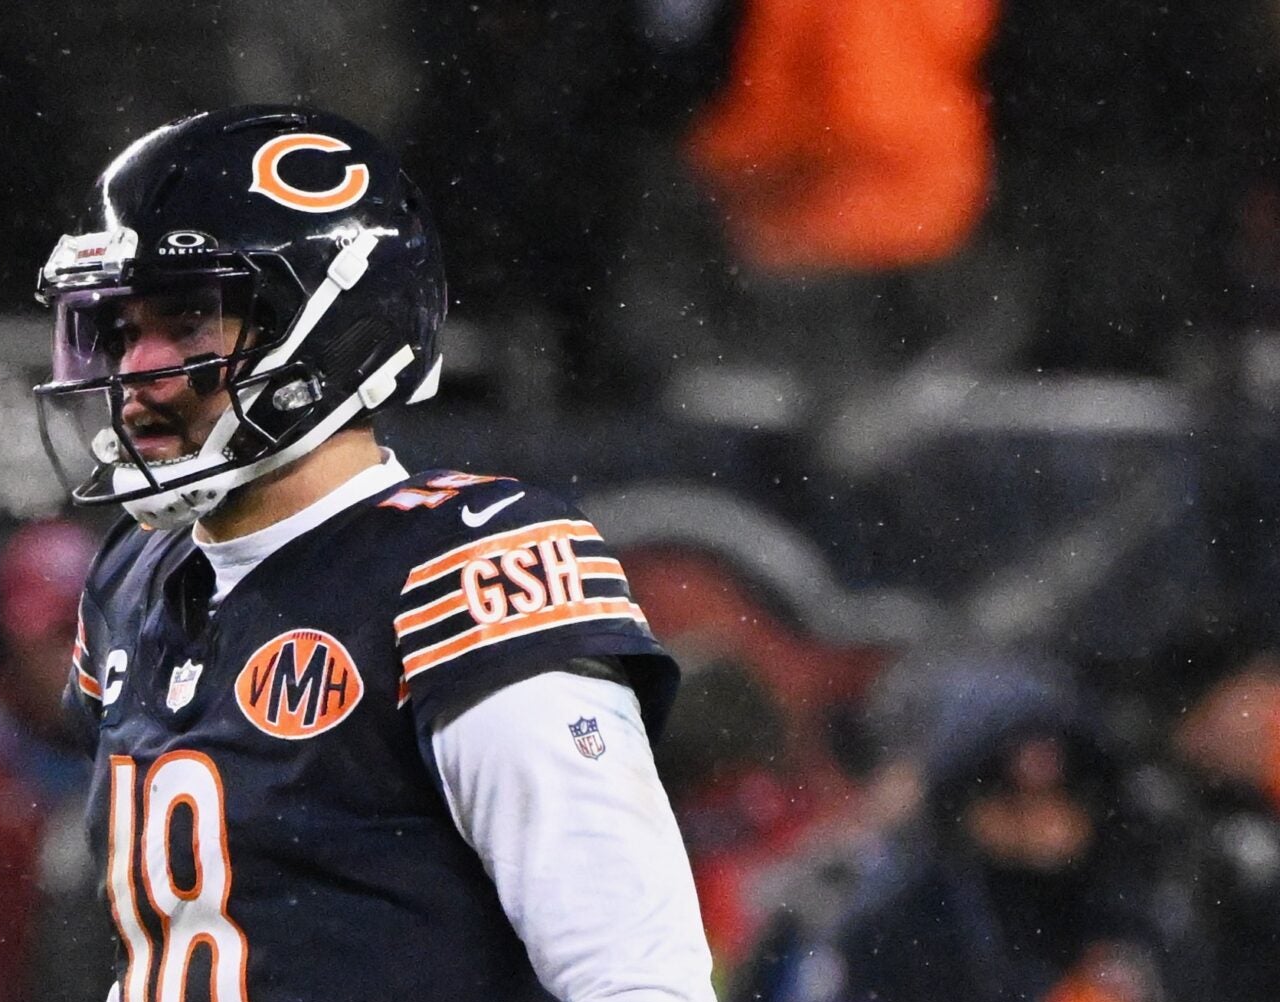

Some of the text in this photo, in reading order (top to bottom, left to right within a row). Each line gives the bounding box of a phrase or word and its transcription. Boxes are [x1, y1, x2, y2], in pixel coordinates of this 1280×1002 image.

[461, 536, 584, 625] GSH
[102, 648, 128, 706] C
[249, 639, 348, 728] VMH
[577, 735, 603, 756] NFL
